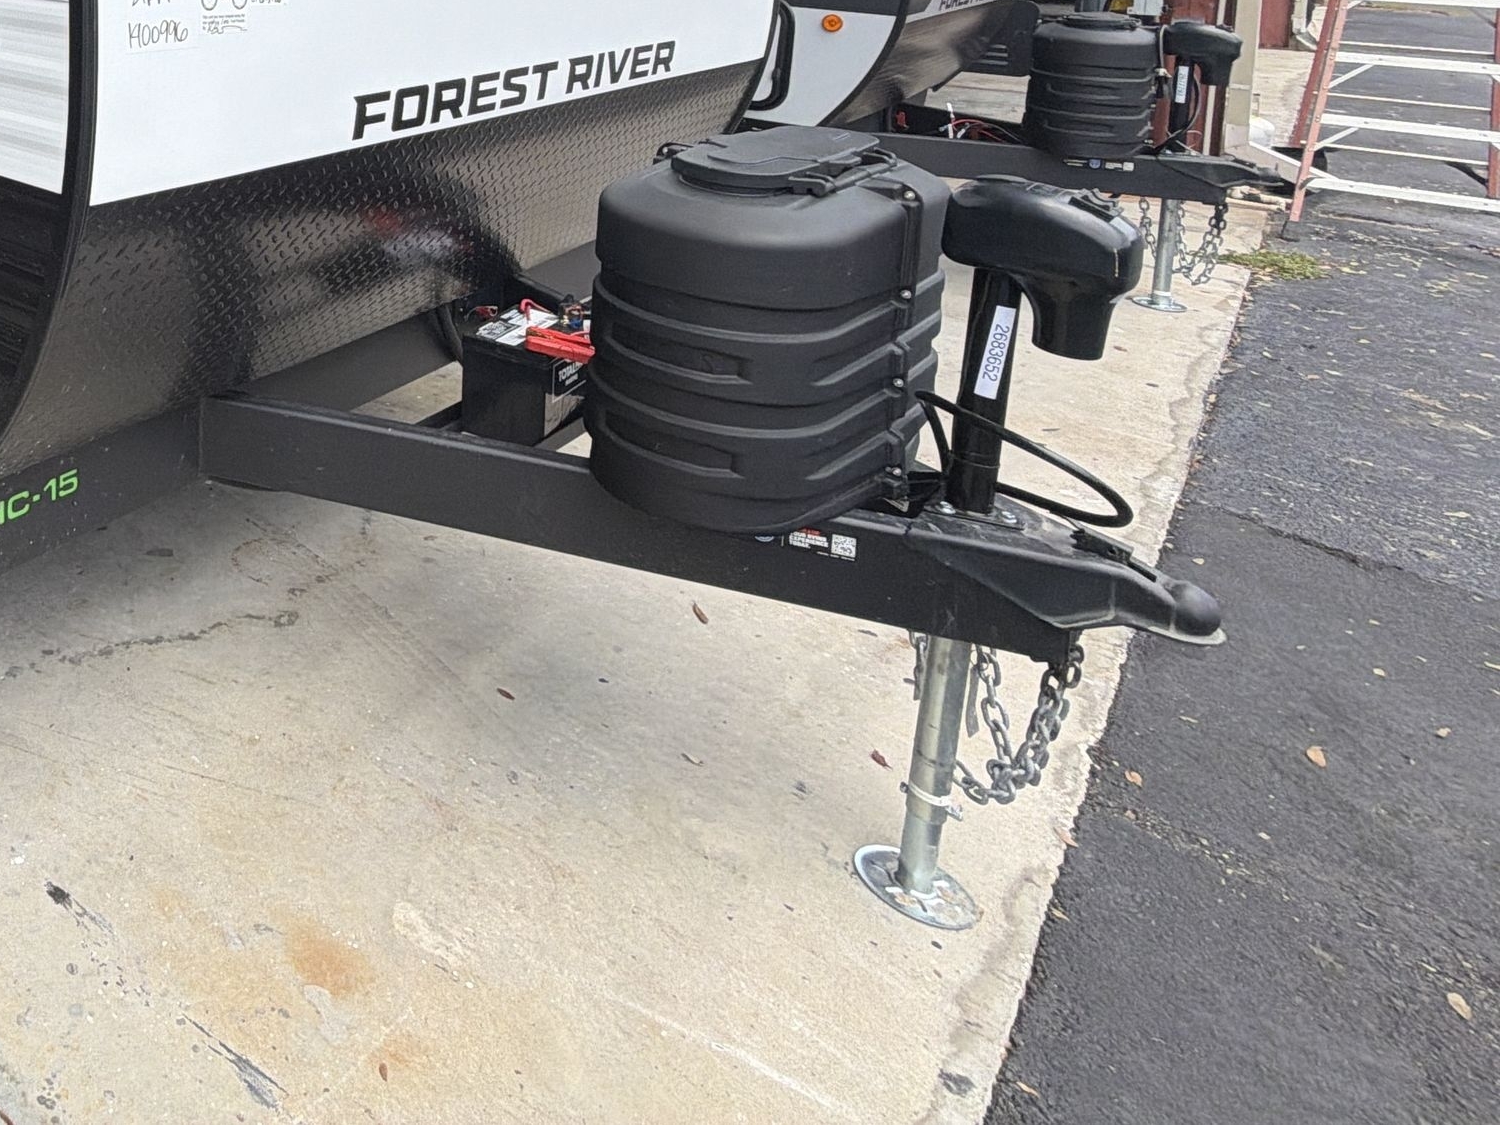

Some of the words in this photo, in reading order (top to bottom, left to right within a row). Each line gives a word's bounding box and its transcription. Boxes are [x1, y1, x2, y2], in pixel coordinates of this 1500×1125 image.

[351, 60, 560, 141] FOREST
[565, 40, 676, 95] RIVER
[981, 323, 1010, 382] 2683652
